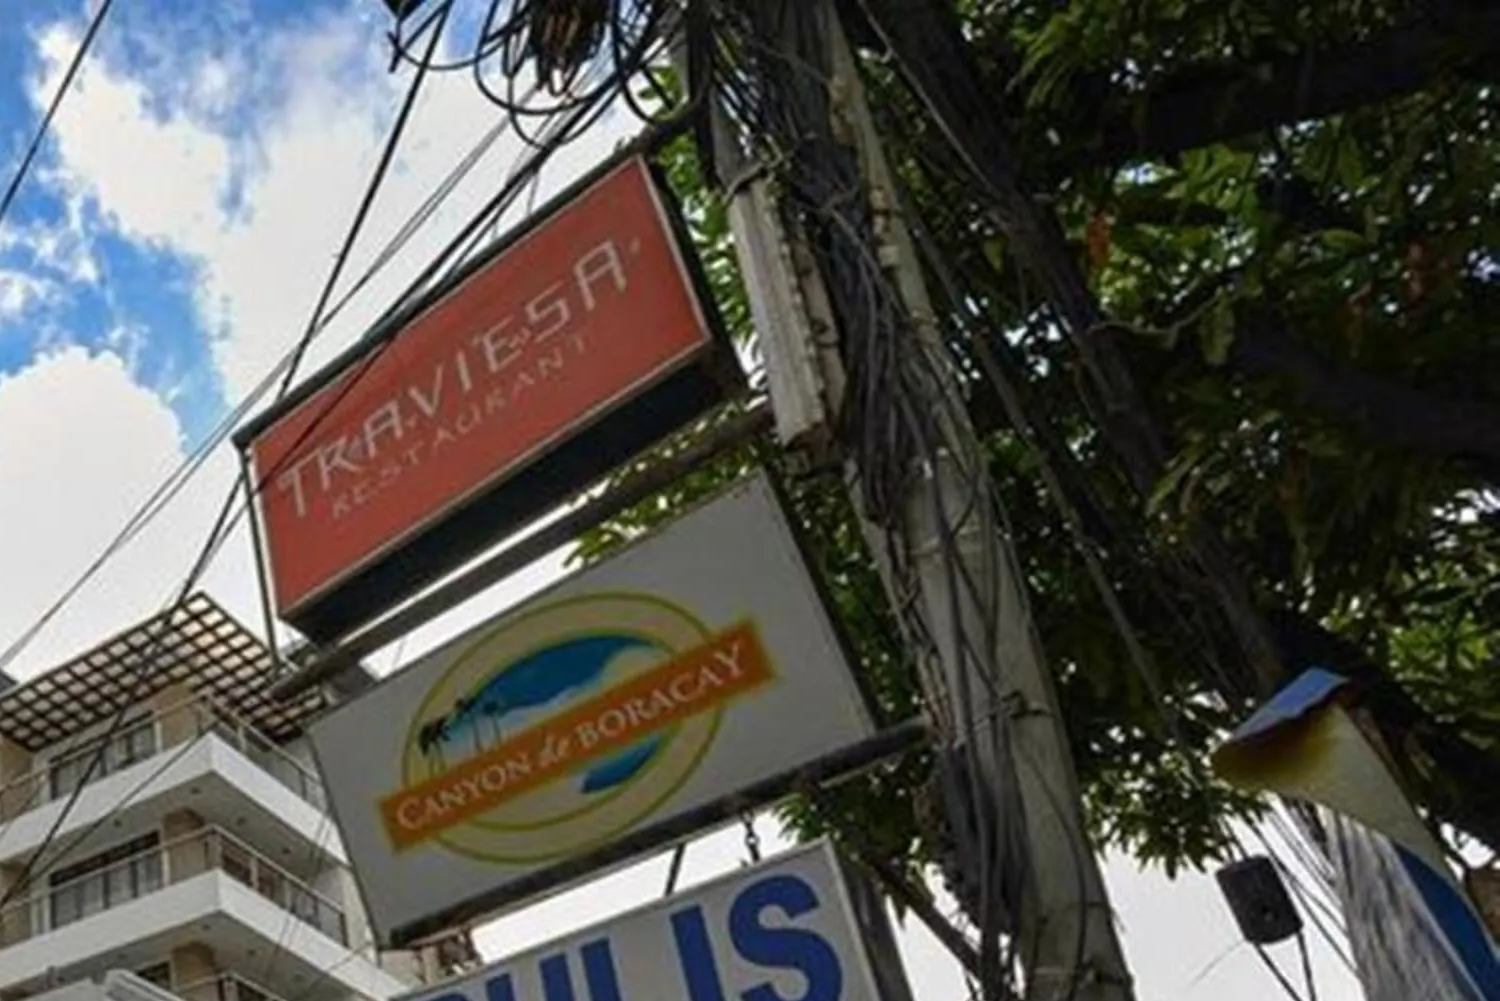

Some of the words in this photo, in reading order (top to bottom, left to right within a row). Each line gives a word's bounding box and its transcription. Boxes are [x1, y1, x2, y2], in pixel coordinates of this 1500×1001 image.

[278, 238, 628, 519] TRAVIESA
[331, 335, 590, 520] RESTAURANT
[394, 756, 532, 831] CANYON
[537, 732, 572, 769] de
[574, 644, 749, 757] BORACAY
